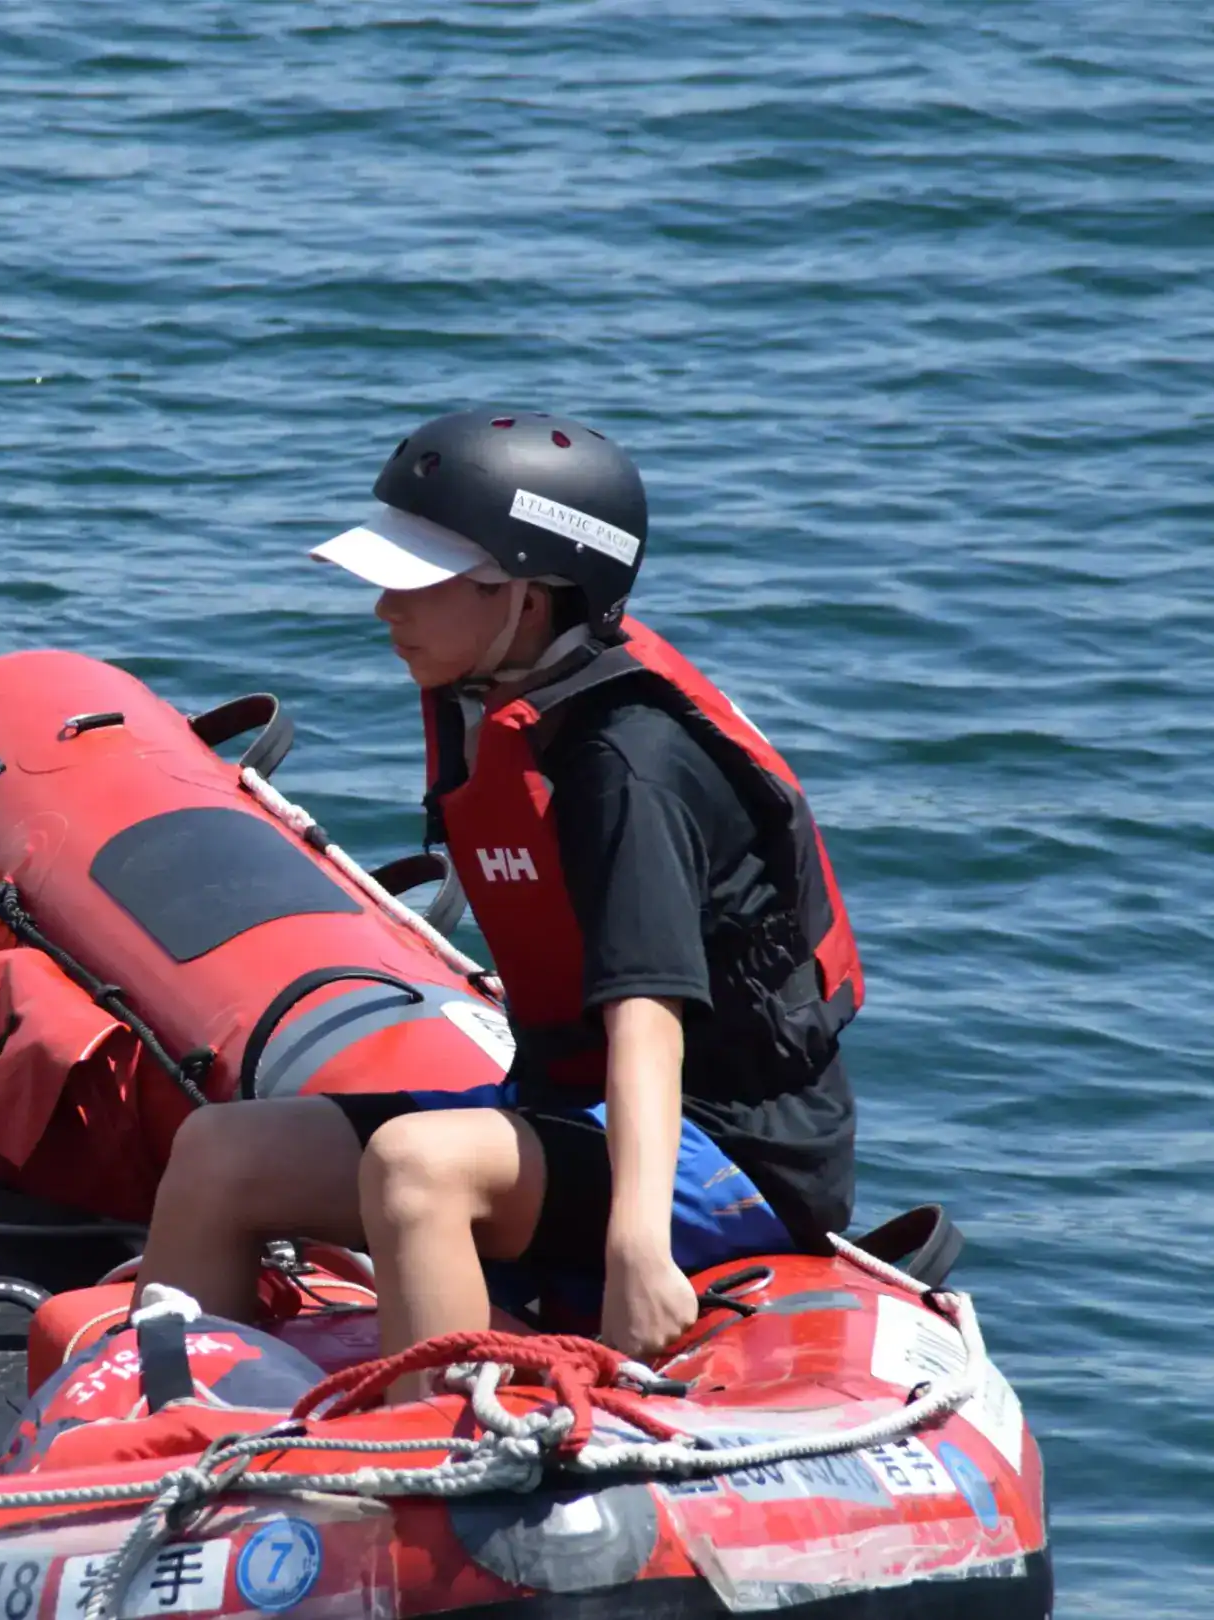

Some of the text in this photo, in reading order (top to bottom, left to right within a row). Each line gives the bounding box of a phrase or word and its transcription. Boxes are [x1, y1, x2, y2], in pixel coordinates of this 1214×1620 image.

[515, 495, 593, 531] ATLANTIC
[476, 847, 539, 882] HH
[266, 1541, 294, 1583] 7
